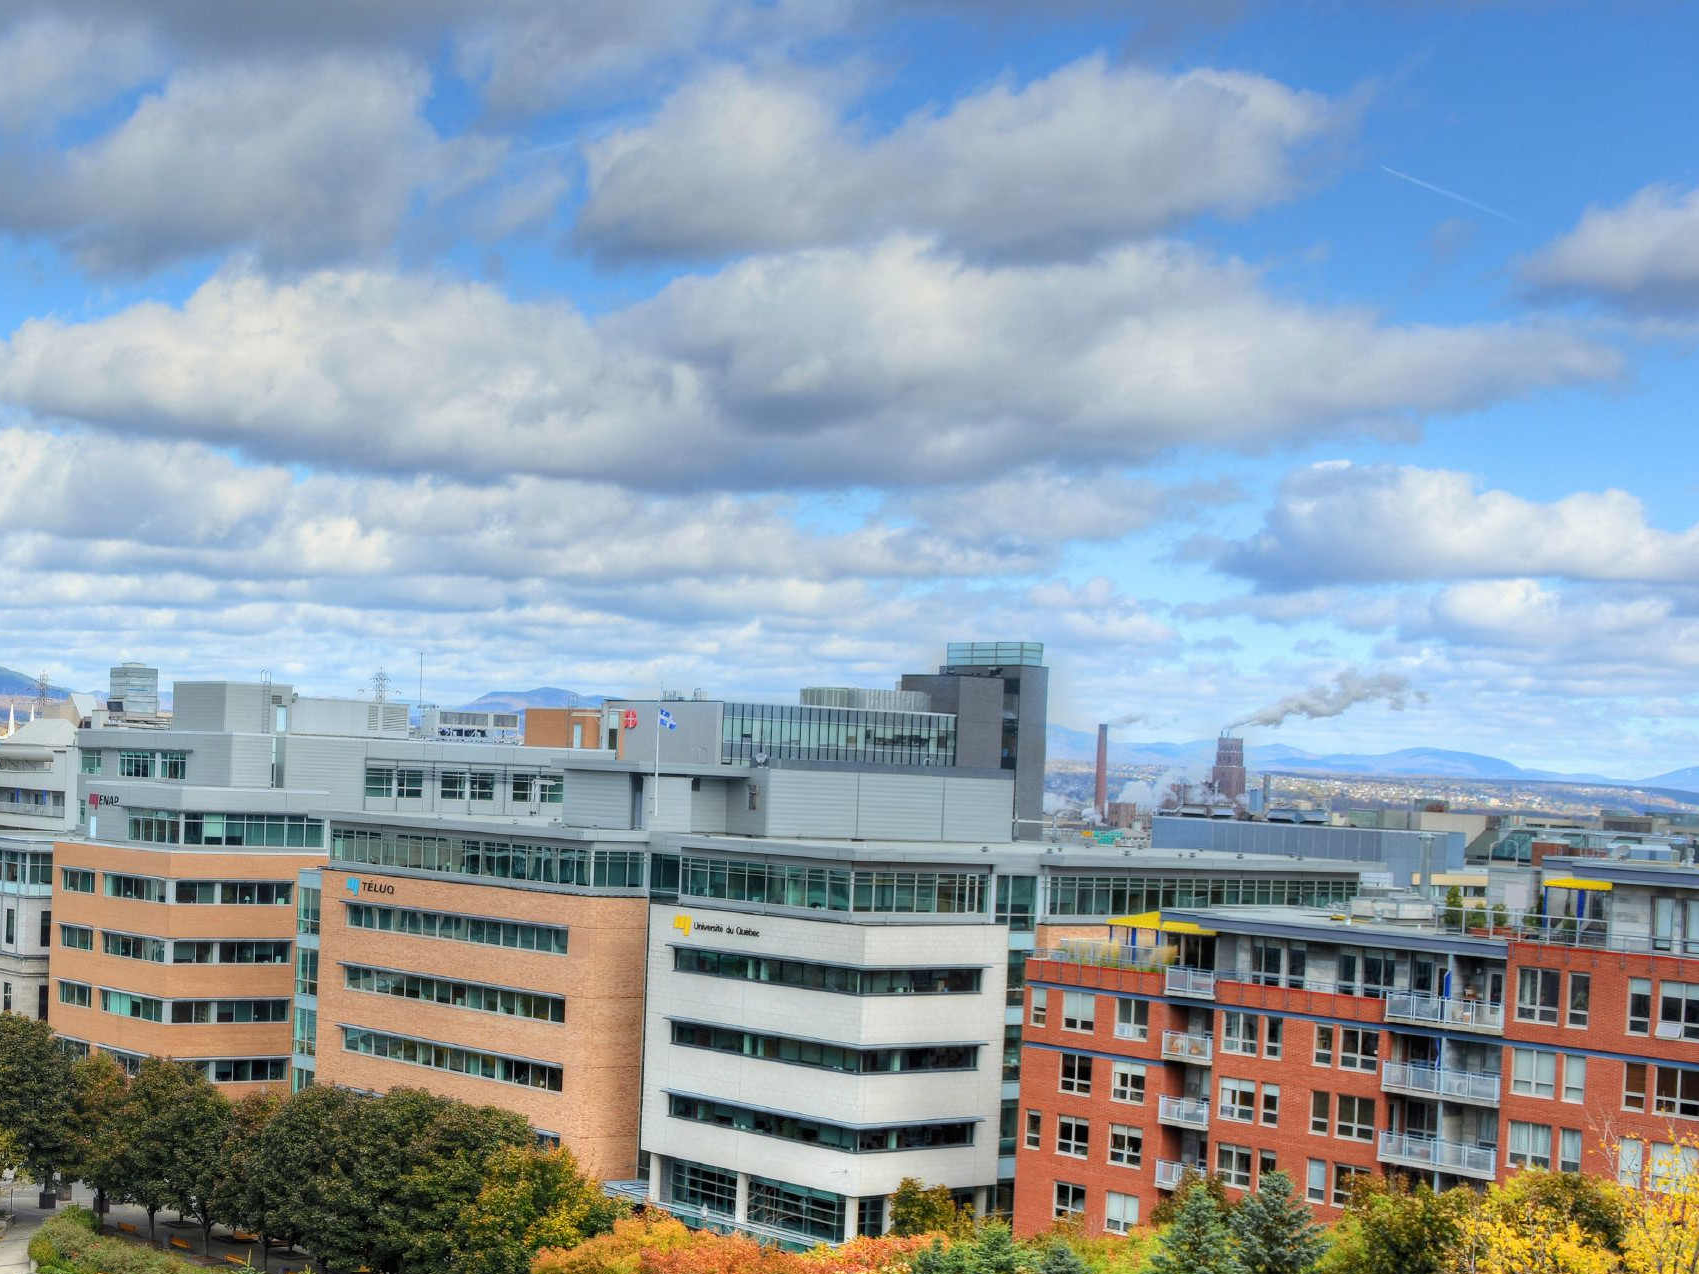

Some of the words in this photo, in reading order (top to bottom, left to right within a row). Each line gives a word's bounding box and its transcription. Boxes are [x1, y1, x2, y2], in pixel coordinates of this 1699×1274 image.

[99, 795, 120, 806] ENAP
[362, 880, 395, 895] TÉLUQ
[693, 921, 723, 933] Université
[725, 925, 734, 935] du
[736, 926, 760, 938] Québec
